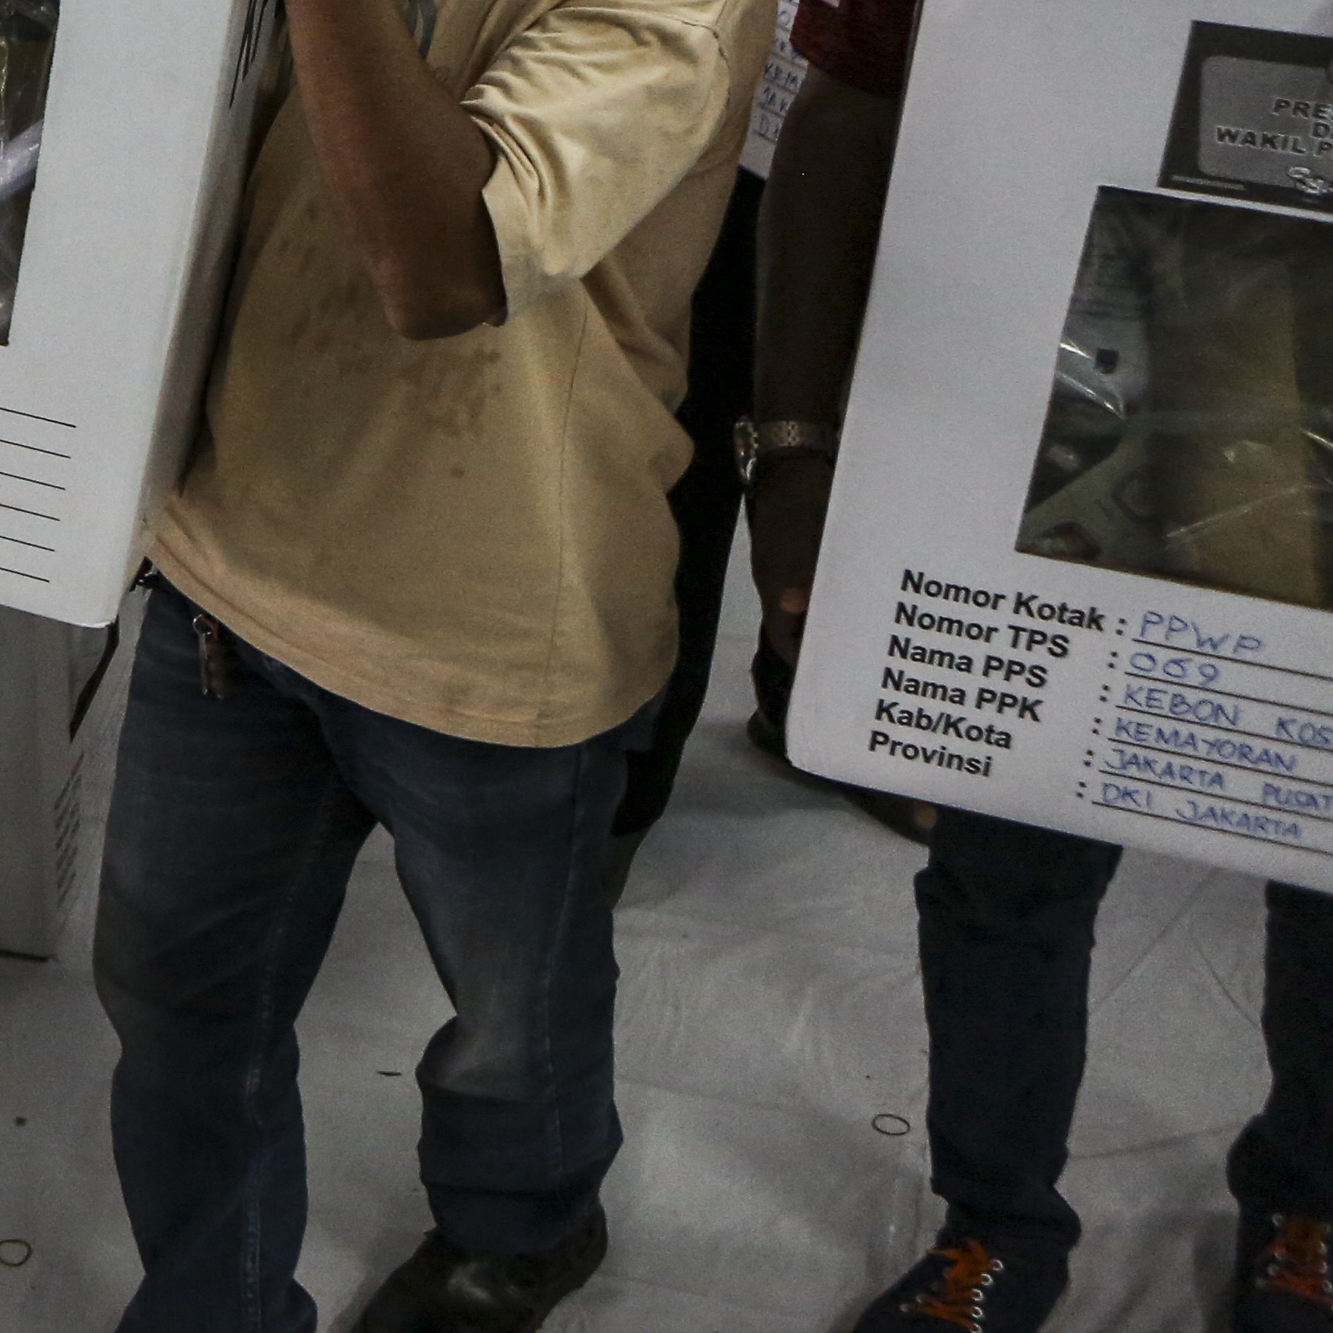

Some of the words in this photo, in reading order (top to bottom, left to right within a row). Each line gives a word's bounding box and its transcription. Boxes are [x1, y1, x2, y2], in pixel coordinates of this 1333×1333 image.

[1215, 125, 1306, 155] WAKIL
[900, 568, 1006, 611] Nomor
[1012, 591, 1106, 632] Kotak
[894, 601, 999, 644] Nomor
[1007, 623, 1070, 658] TPS
[1139, 610, 1263, 653] PPWP
[888, 634, 974, 674] Nama
[982, 654, 1048, 689] PPS
[881, 666, 966, 707] Nama
[974, 686, 1044, 723] PPK
[1124, 684, 1241, 727] KEBON
[1275, 716, 1333, 746] KOS
[874, 698, 1013, 750] Kab/Kota
[1114, 717, 1297, 772] KEMAYORAN
[868, 729, 993, 778] Provinsi
[1105, 747, 1225, 790] JAKARTA
[1102, 782, 1152, 807] DKI
[1176, 799, 1302, 838] JAKARTA
